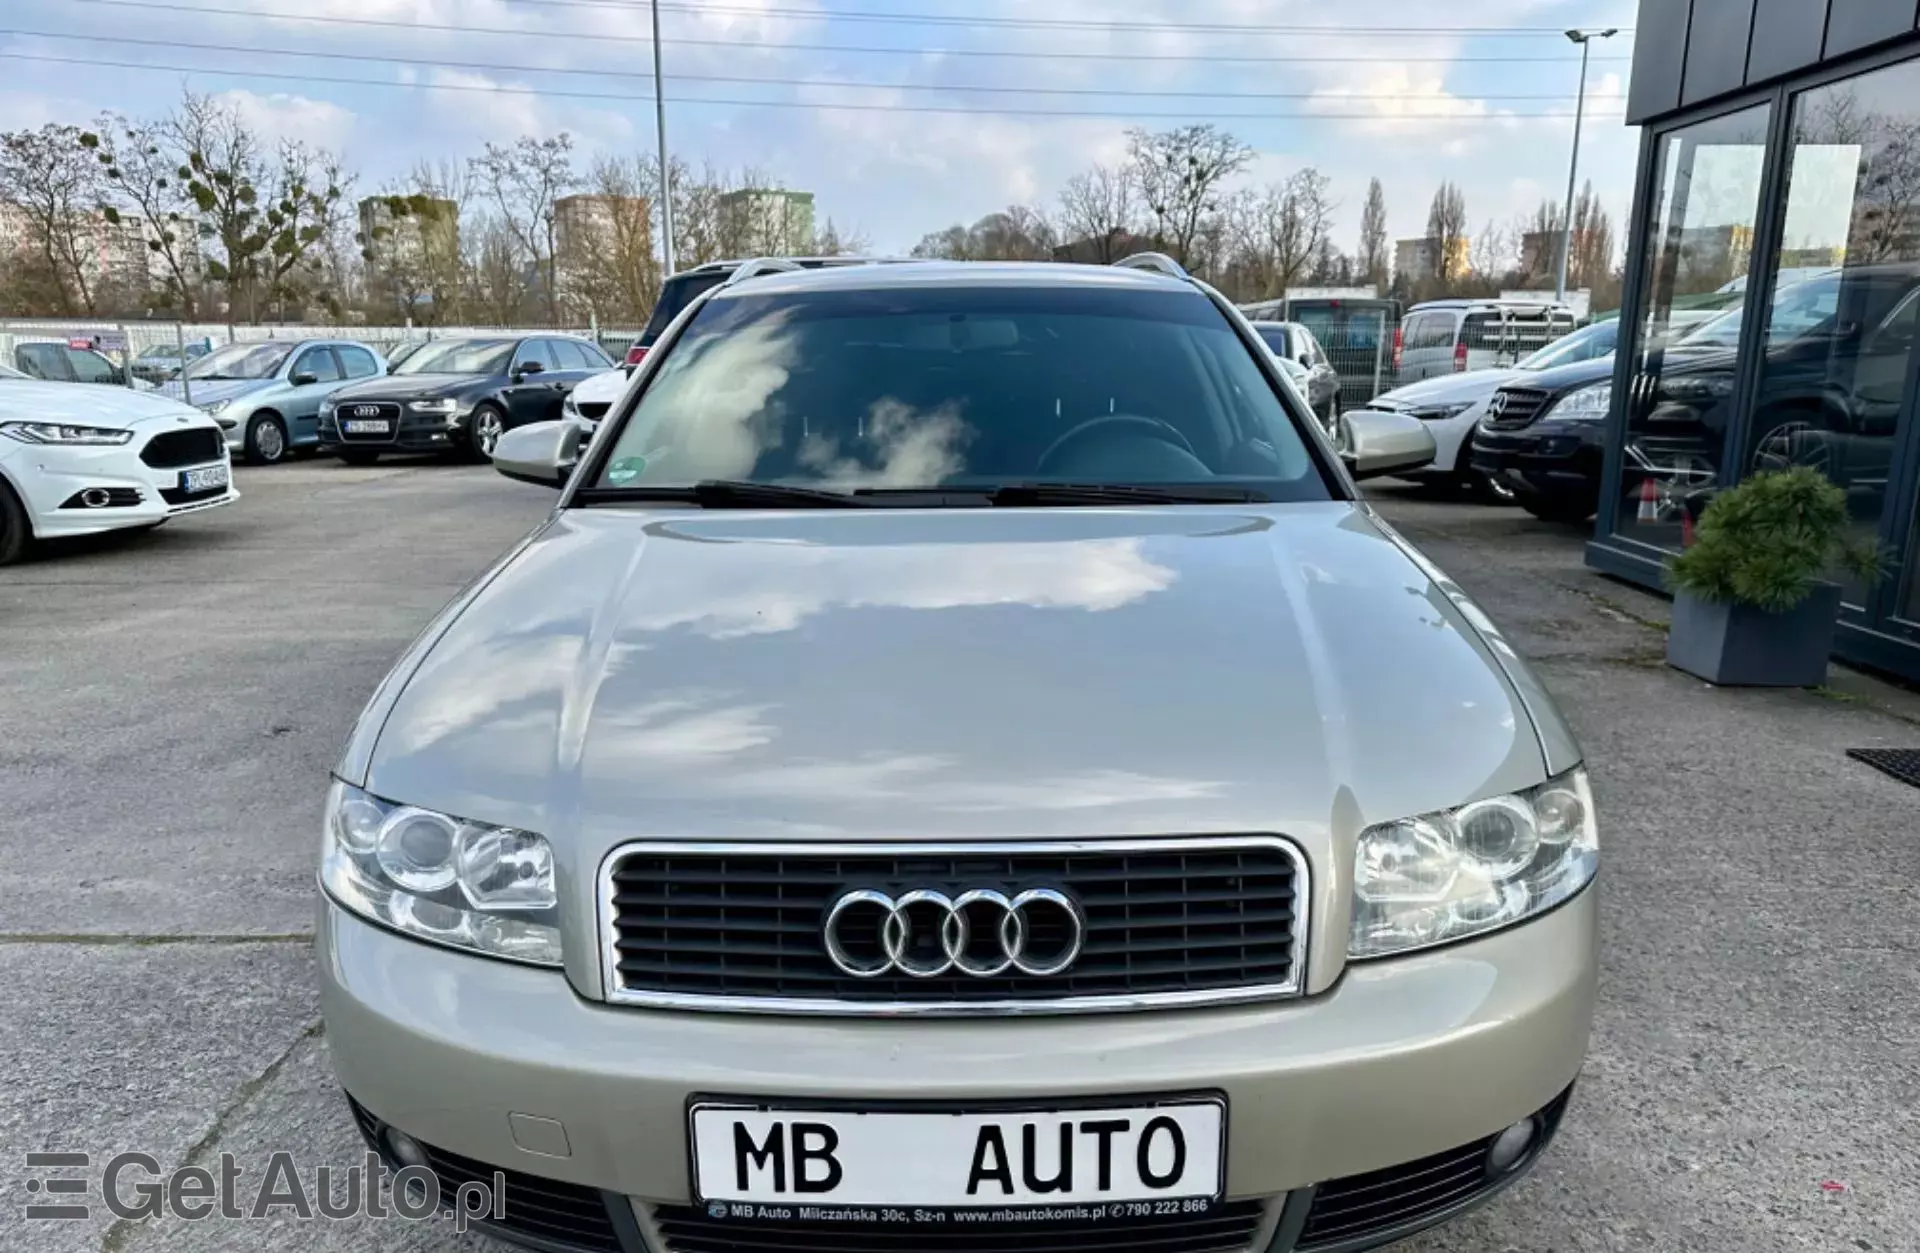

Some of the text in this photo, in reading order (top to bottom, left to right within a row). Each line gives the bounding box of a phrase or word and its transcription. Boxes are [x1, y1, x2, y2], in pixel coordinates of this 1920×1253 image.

[732, 1115, 1187, 1195] MB AUTO
[731, 1203, 754, 1218] MB
[757, 1205, 791, 1219] Auto
[799, 1206, 877, 1222] Milczańska
[914, 1208, 946, 1222] Sz-n
[953, 1205, 1106, 1222] www.mbautokomis.pl
[1126, 1202, 1150, 1216] 790
[1154, 1200, 1180, 1214] 222
[1183, 1198, 1208, 1212] 866
